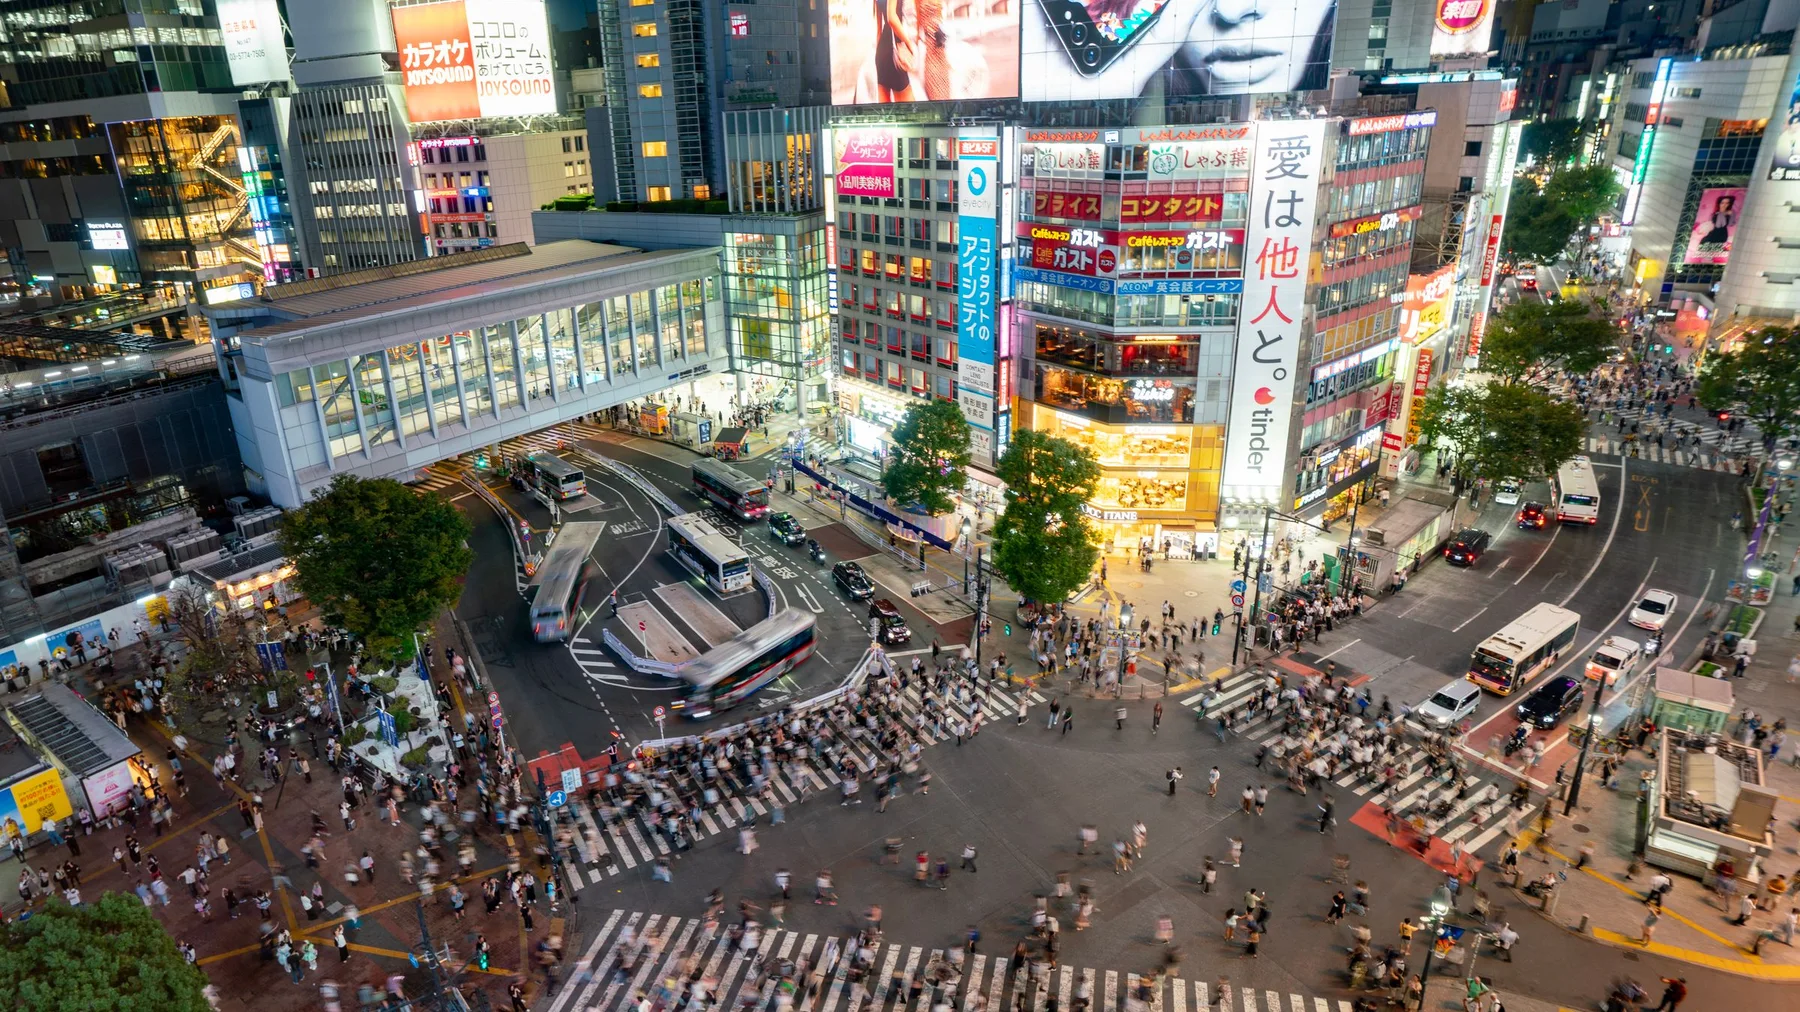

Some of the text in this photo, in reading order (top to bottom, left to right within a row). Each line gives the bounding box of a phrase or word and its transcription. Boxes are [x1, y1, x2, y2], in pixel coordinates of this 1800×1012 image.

[472, 22, 528, 39] ココロの
[403, 39, 468, 68] カラオケ
[475, 41, 547, 60] ボリューム、
[407, 65, 473, 86] JOYSOUND
[478, 62, 549, 77] あげていこう。
[479, 79, 551, 97] JOYSOUND
[1025, 130, 1099, 142] しゃぶしゃぶバイキング
[1140, 127, 1250, 142] しゃぶしゃぶバイキング
[860, 147, 888, 159] クリニック
[1022, 153, 1034, 166] 9F
[1058, 151, 1100, 169] しゃぶ葉
[1184, 146, 1248, 169] しゃぶ葉
[843, 176, 892, 191] 品川美容外科
[962, 199, 992, 211] eyecity
[1036, 193, 1100, 215] プライス
[1121, 196, 1220, 217] コンタクト
[1070, 228, 1104, 248] ガスト
[1186, 231, 1234, 249] ガスト
[1019, 245, 1034, 259] 7F
[1036, 247, 1053, 258] Café
[1053, 246, 1093, 271] ガスト
[1250, 134, 1311, 381] 愛は他人と。
[962, 235, 978, 339] アイシティ
[979, 237, 991, 341] コンタクトの
[1040, 271, 1097, 289] 英会話イーオン
[1122, 281, 1240, 294] AEON 英会話イーオン
[966, 364, 986, 375] CONTACT
[970, 372, 981, 380] LENS
[962, 375, 990, 389] SPECIALISTS
[1370, 396, 1387, 415] アコム
[1247, 408, 1274, 475] tinder
